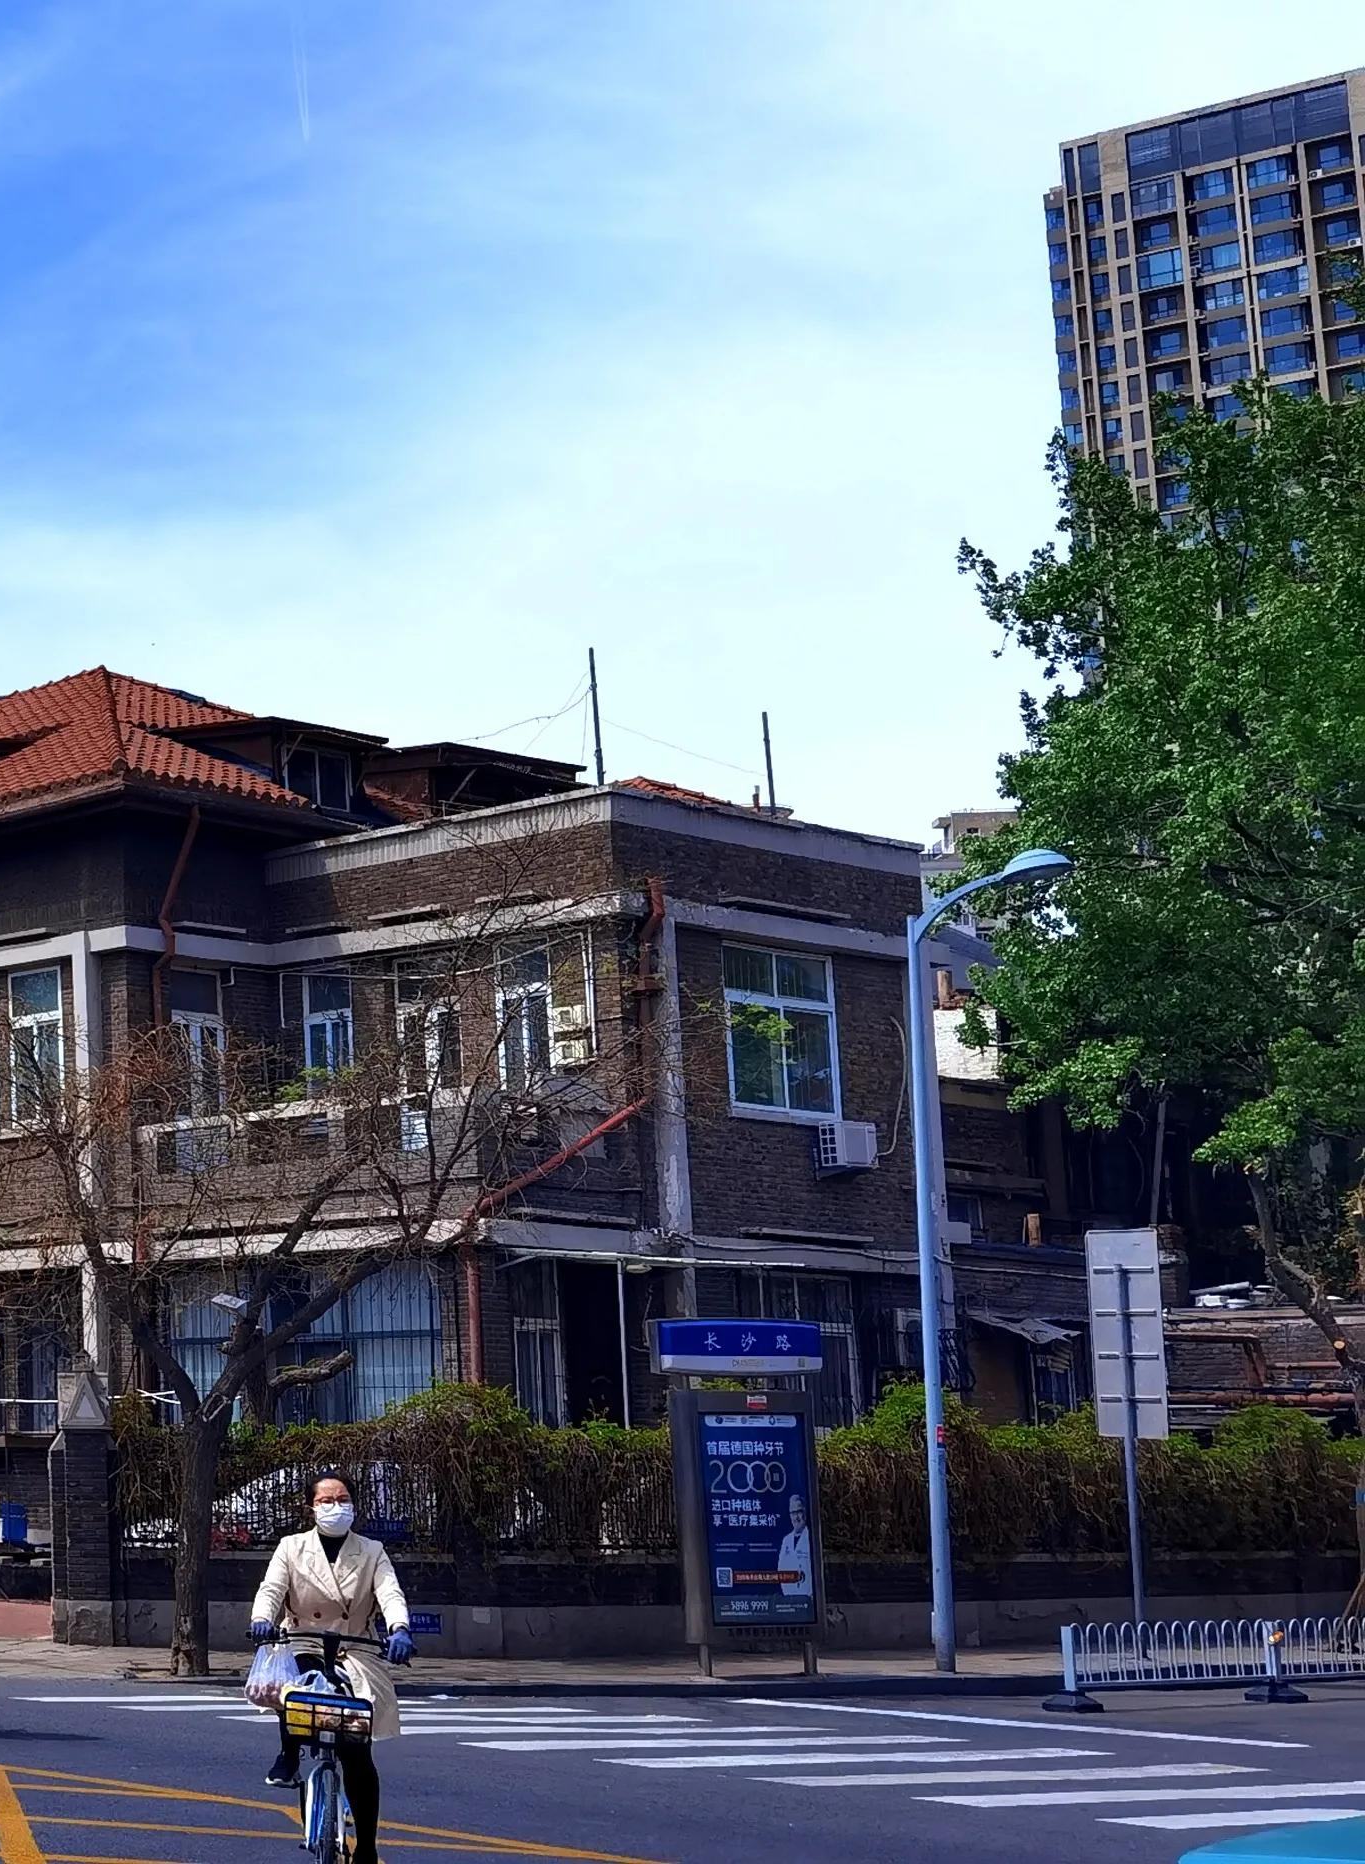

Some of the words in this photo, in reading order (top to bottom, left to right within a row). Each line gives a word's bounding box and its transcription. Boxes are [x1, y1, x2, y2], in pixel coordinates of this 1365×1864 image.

[704, 1331, 792, 1352] 长沙路
[706, 1441, 784, 1456] 首届德国种牙节
[709, 1459, 787, 1494] 2000
[711, 1498, 762, 1512] 进口种植体
